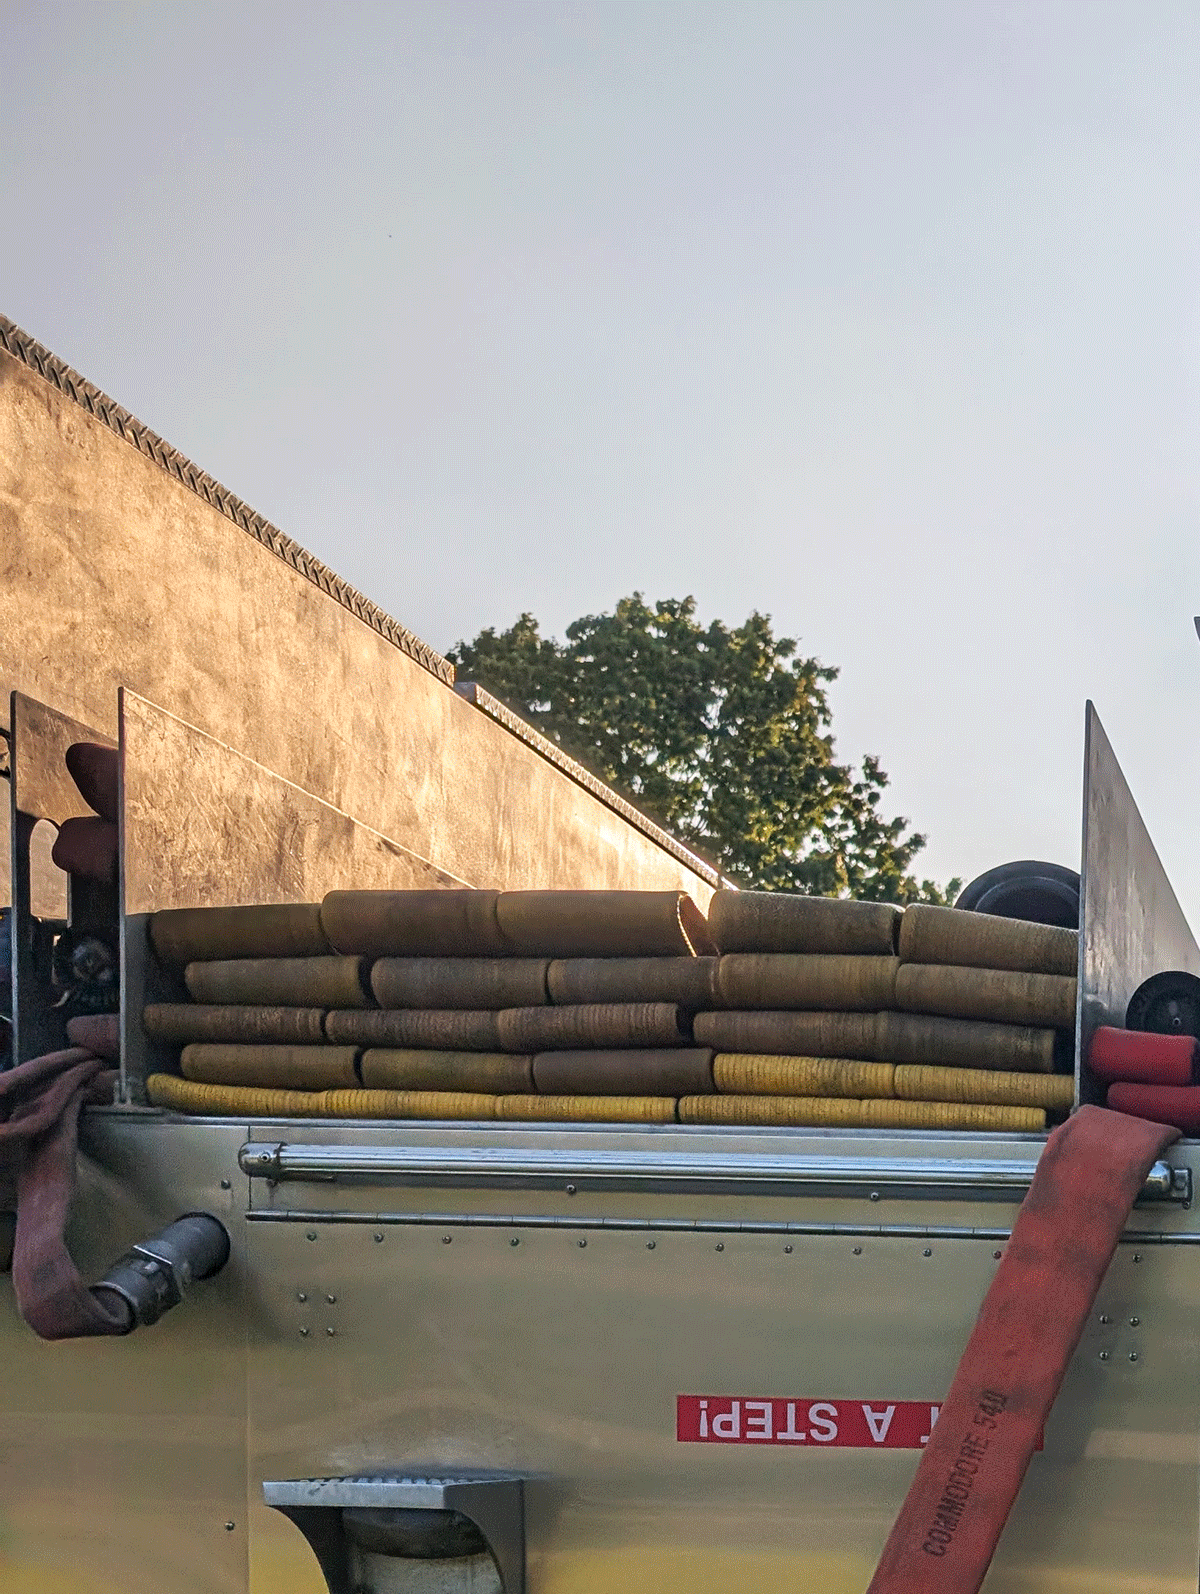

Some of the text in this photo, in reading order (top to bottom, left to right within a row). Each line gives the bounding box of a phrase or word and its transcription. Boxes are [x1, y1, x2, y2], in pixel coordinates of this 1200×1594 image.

[699, 1400, 839, 1442] STEP!
[861, 1404, 897, 1442] A
[922, 1432, 990, 1557] COMMODORE
